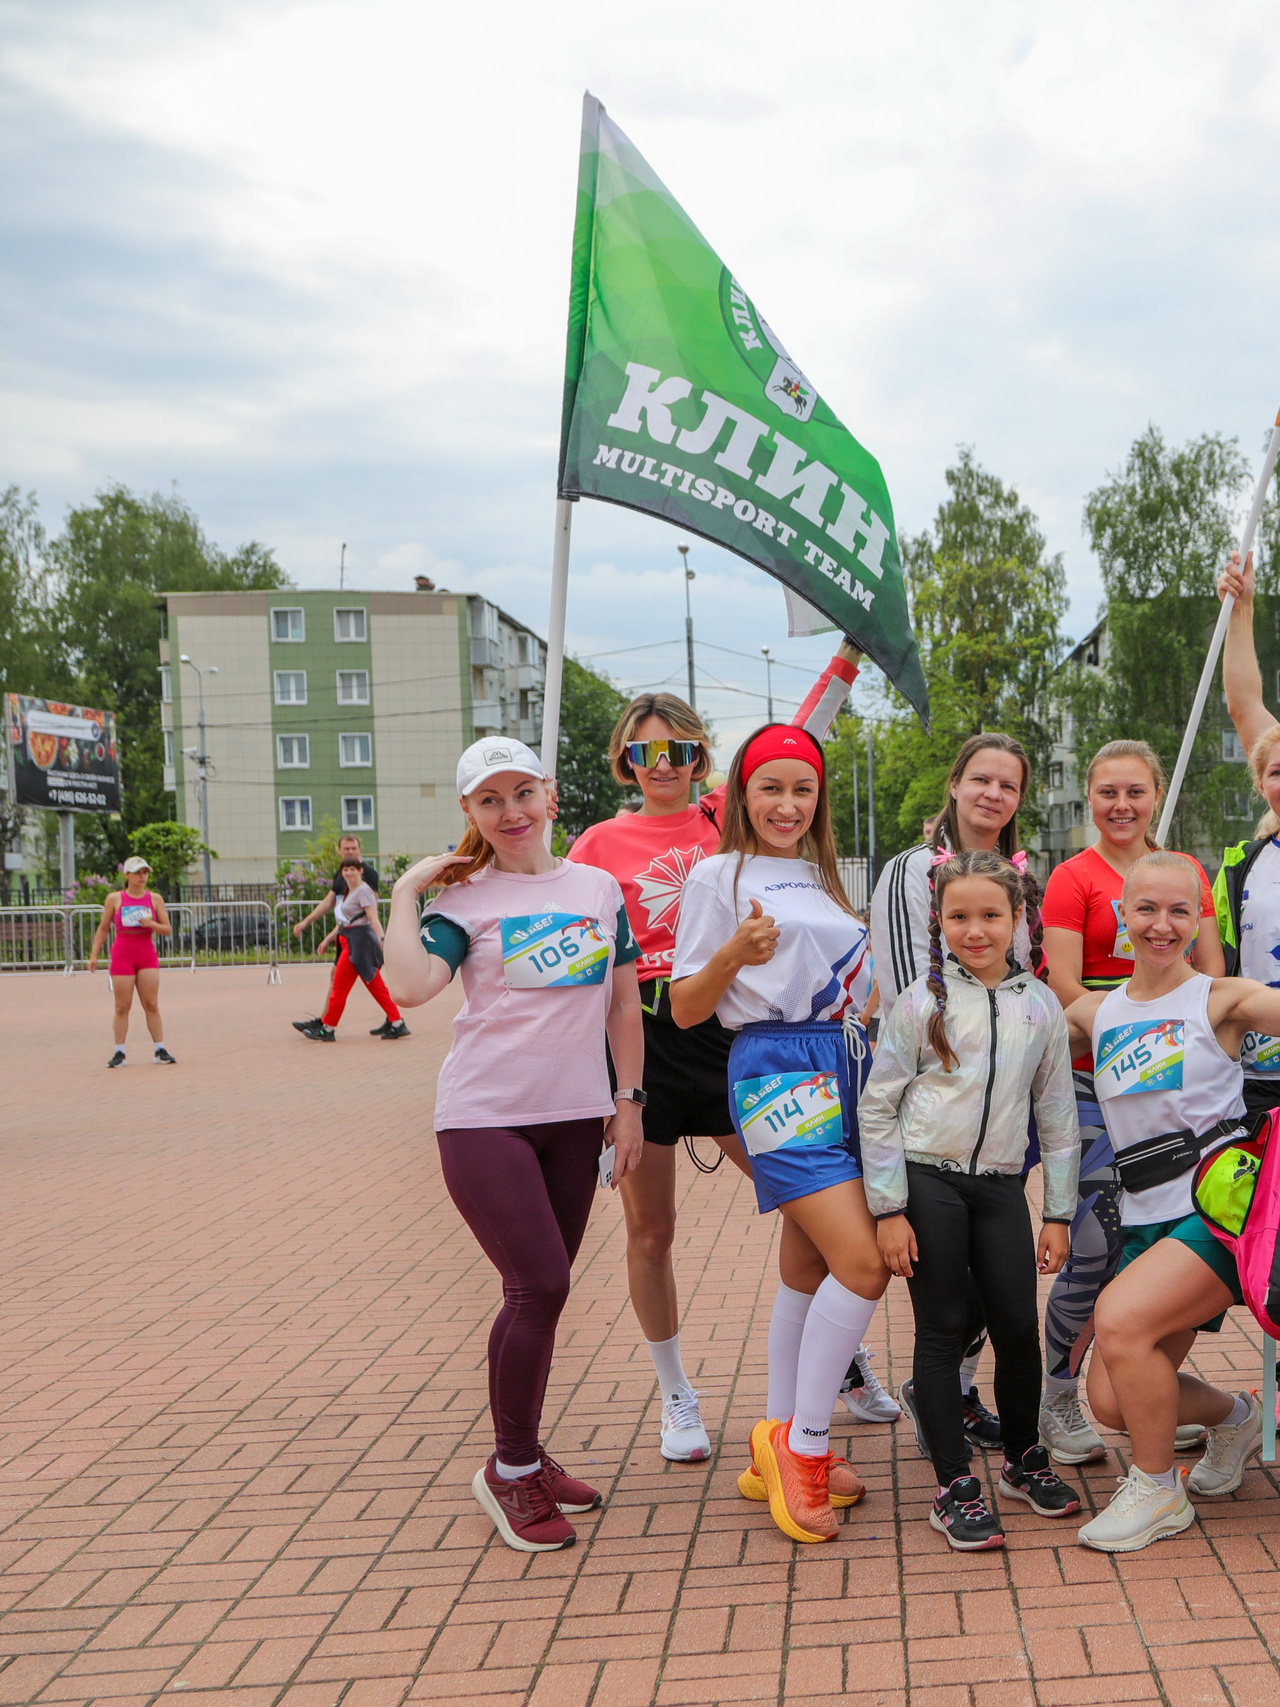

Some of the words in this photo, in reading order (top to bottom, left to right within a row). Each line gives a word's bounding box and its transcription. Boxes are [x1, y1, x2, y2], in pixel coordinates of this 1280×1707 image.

[607, 361, 891, 579] КЛИН
[593, 444, 798, 548] MULTISPORT
[804, 539, 876, 611] TEAM
[764, 881, 827, 893] АЭРОФЛО
[528, 935, 580, 974] 106
[575, 955, 595, 969] КЛИН
[1111, 1043, 1152, 1082] 145
[1263, 1044, 1280, 1057] КЛИН
[1146, 1061, 1167, 1075] КЛИН
[764, 1098, 804, 1133] 114
[803, 1114, 825, 1129] КЛИН
